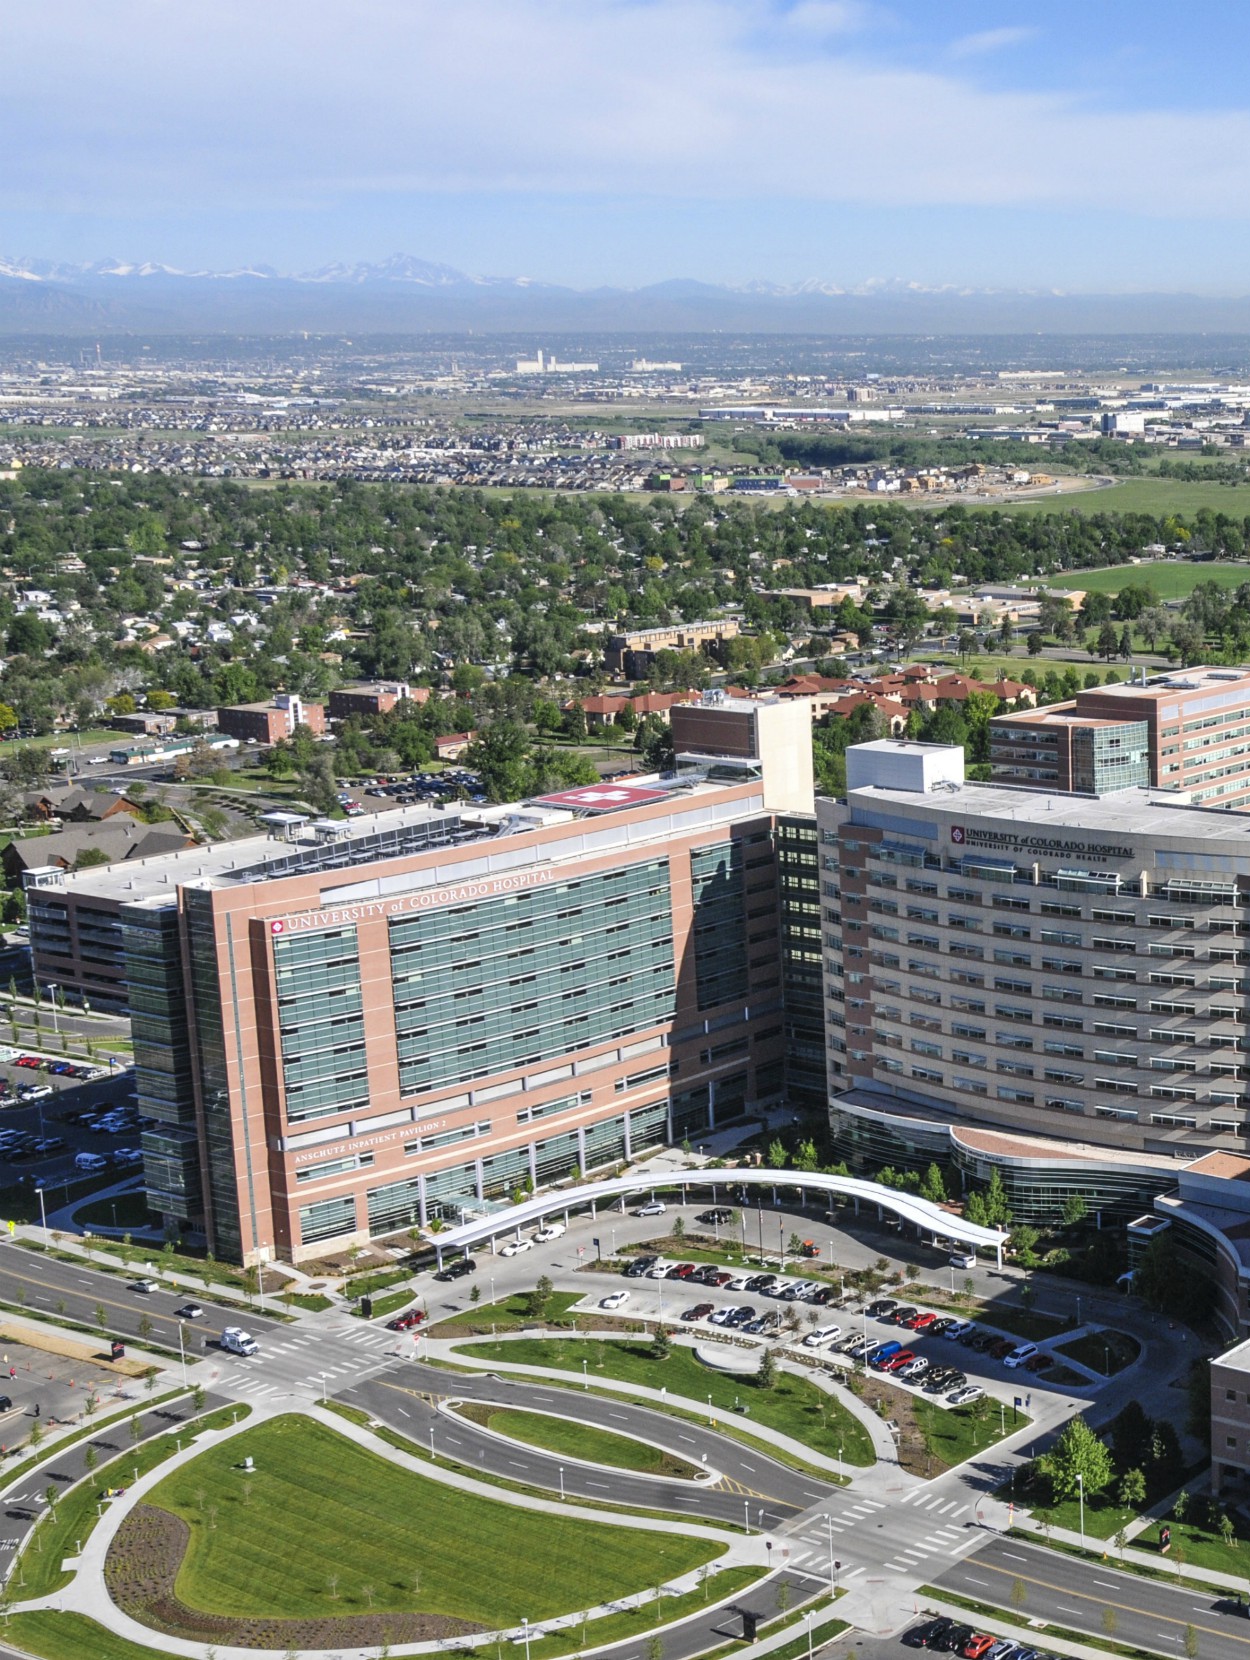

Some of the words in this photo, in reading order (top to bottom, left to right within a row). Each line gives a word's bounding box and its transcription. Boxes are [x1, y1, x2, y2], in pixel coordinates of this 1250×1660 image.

[966, 828, 1019, 843] UNIVERSITY
[1021, 836, 1029, 844] of
[1030, 837, 1085, 851] COLORADO
[1087, 844, 1135, 856] HOSPITAL
[966, 840, 1009, 851] UNIVERSITY
[1027, 848, 1071, 859] COLORADO
[1076, 854, 1107, 862] HEALTH
[288, 903, 385, 929] UNIVERSITY
[391, 899, 404, 912] of
[410, 884, 488, 908] COLORADO
[493, 870, 554, 891] HOSPITAL
[295, 1146, 346, 1163] ANSCHUTZ
[348, 1132, 397, 1150] INPATIENT
[399, 1121, 439, 1138] PAVILION
